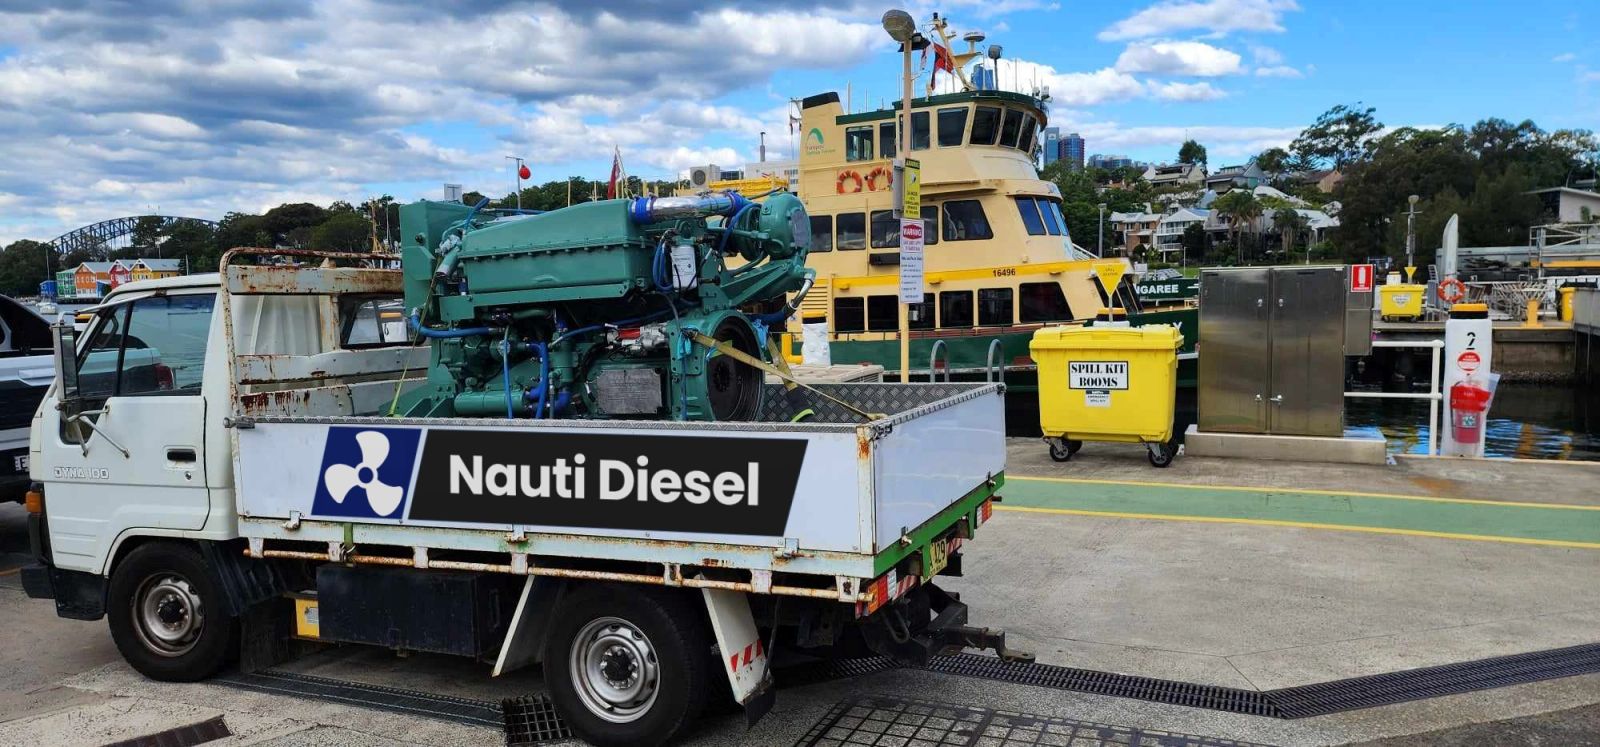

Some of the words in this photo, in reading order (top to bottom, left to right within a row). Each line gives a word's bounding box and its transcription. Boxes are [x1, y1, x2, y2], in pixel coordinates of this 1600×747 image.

[992, 268, 1016, 277] 16496
[1466, 331, 1476, 350] 2
[1071, 364, 1103, 374] SPILL
[1106, 364, 1126, 374] KIT
[1079, 377, 1118, 387] BOOMS
[54, 466, 86, 479] DYNA
[89, 467, 109, 480] 100
[450, 453, 586, 499] Nauti
[600, 455, 759, 506] Diesel
